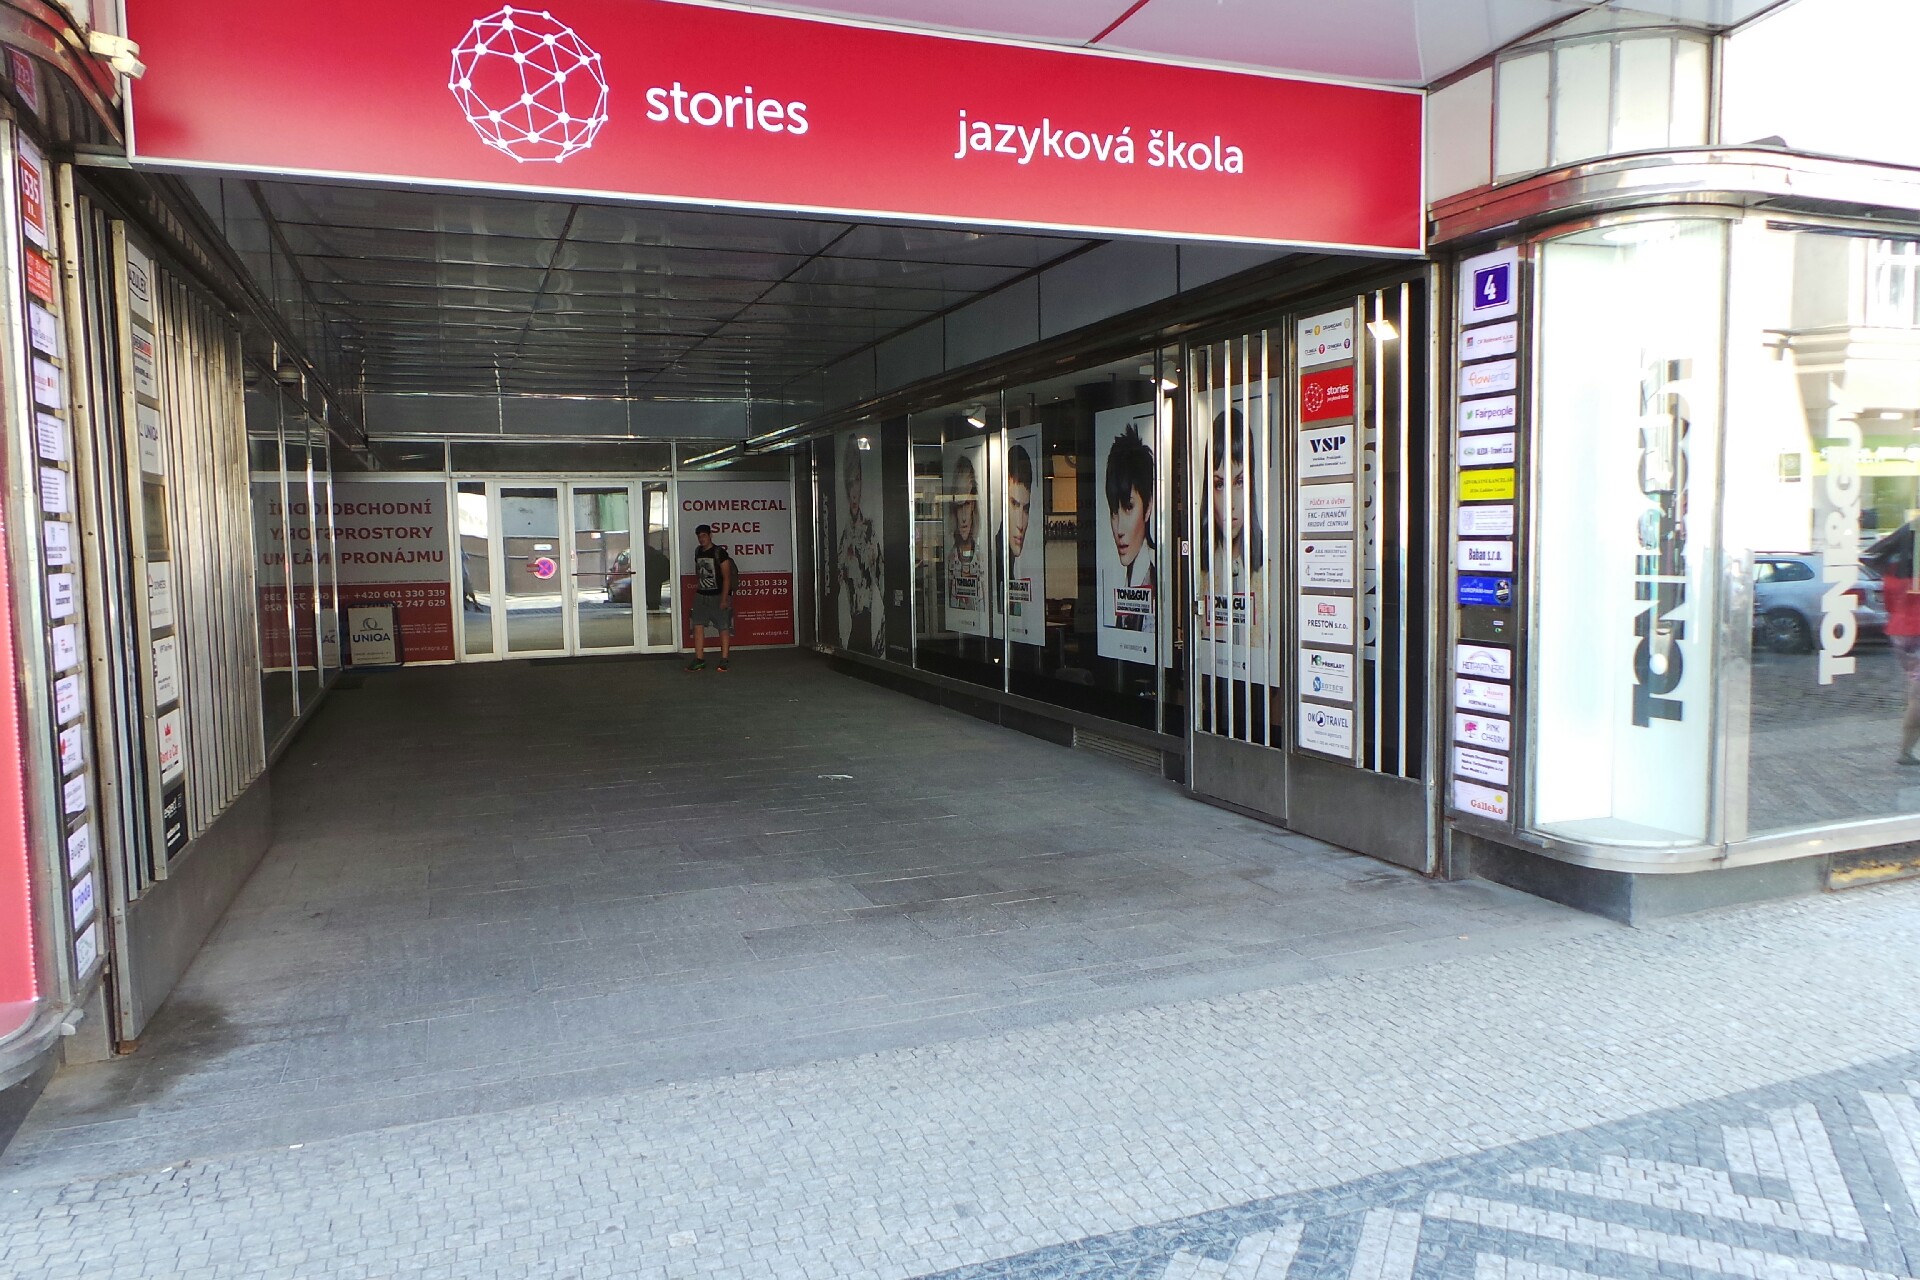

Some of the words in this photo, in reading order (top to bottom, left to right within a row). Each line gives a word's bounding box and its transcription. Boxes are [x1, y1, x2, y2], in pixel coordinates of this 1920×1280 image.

[645, 82, 809, 135] stories
[954, 109, 1135, 165] jazyková
[1147, 128, 1244, 173] škola
[1483, 274, 1497, 300] 4
[1326, 384, 1350, 396] stories
[1475, 406, 1513, 420] Fairpeople
[1310, 436, 1346, 453] VSP
[332, 499, 432, 516] OBCHODNÍ
[682, 499, 787, 512] COMMERCIAL
[332, 527, 434, 541] PROSTORY
[711, 522, 761, 534] SPACE
[734, 543, 775, 556] RENT
[1468, 548, 1486, 560] Baban
[341, 548, 444, 565] PRONÁJMU
[754, 579, 770, 587] 330
[383, 590, 402, 598] 601
[405, 589, 424, 598] 330
[427, 589, 446, 597] 339
[754, 588, 770, 596] 747
[1116, 588, 1150, 602] TONI&GUY
[406, 599, 425, 608] 747
[427, 599, 446, 607] 629
[1307, 619, 1334, 629] PRESTON
[352, 632, 391, 643] UNIQA
[1326, 715, 1349, 728] TRAVEL
[1470, 799, 1504, 815] Galleko
